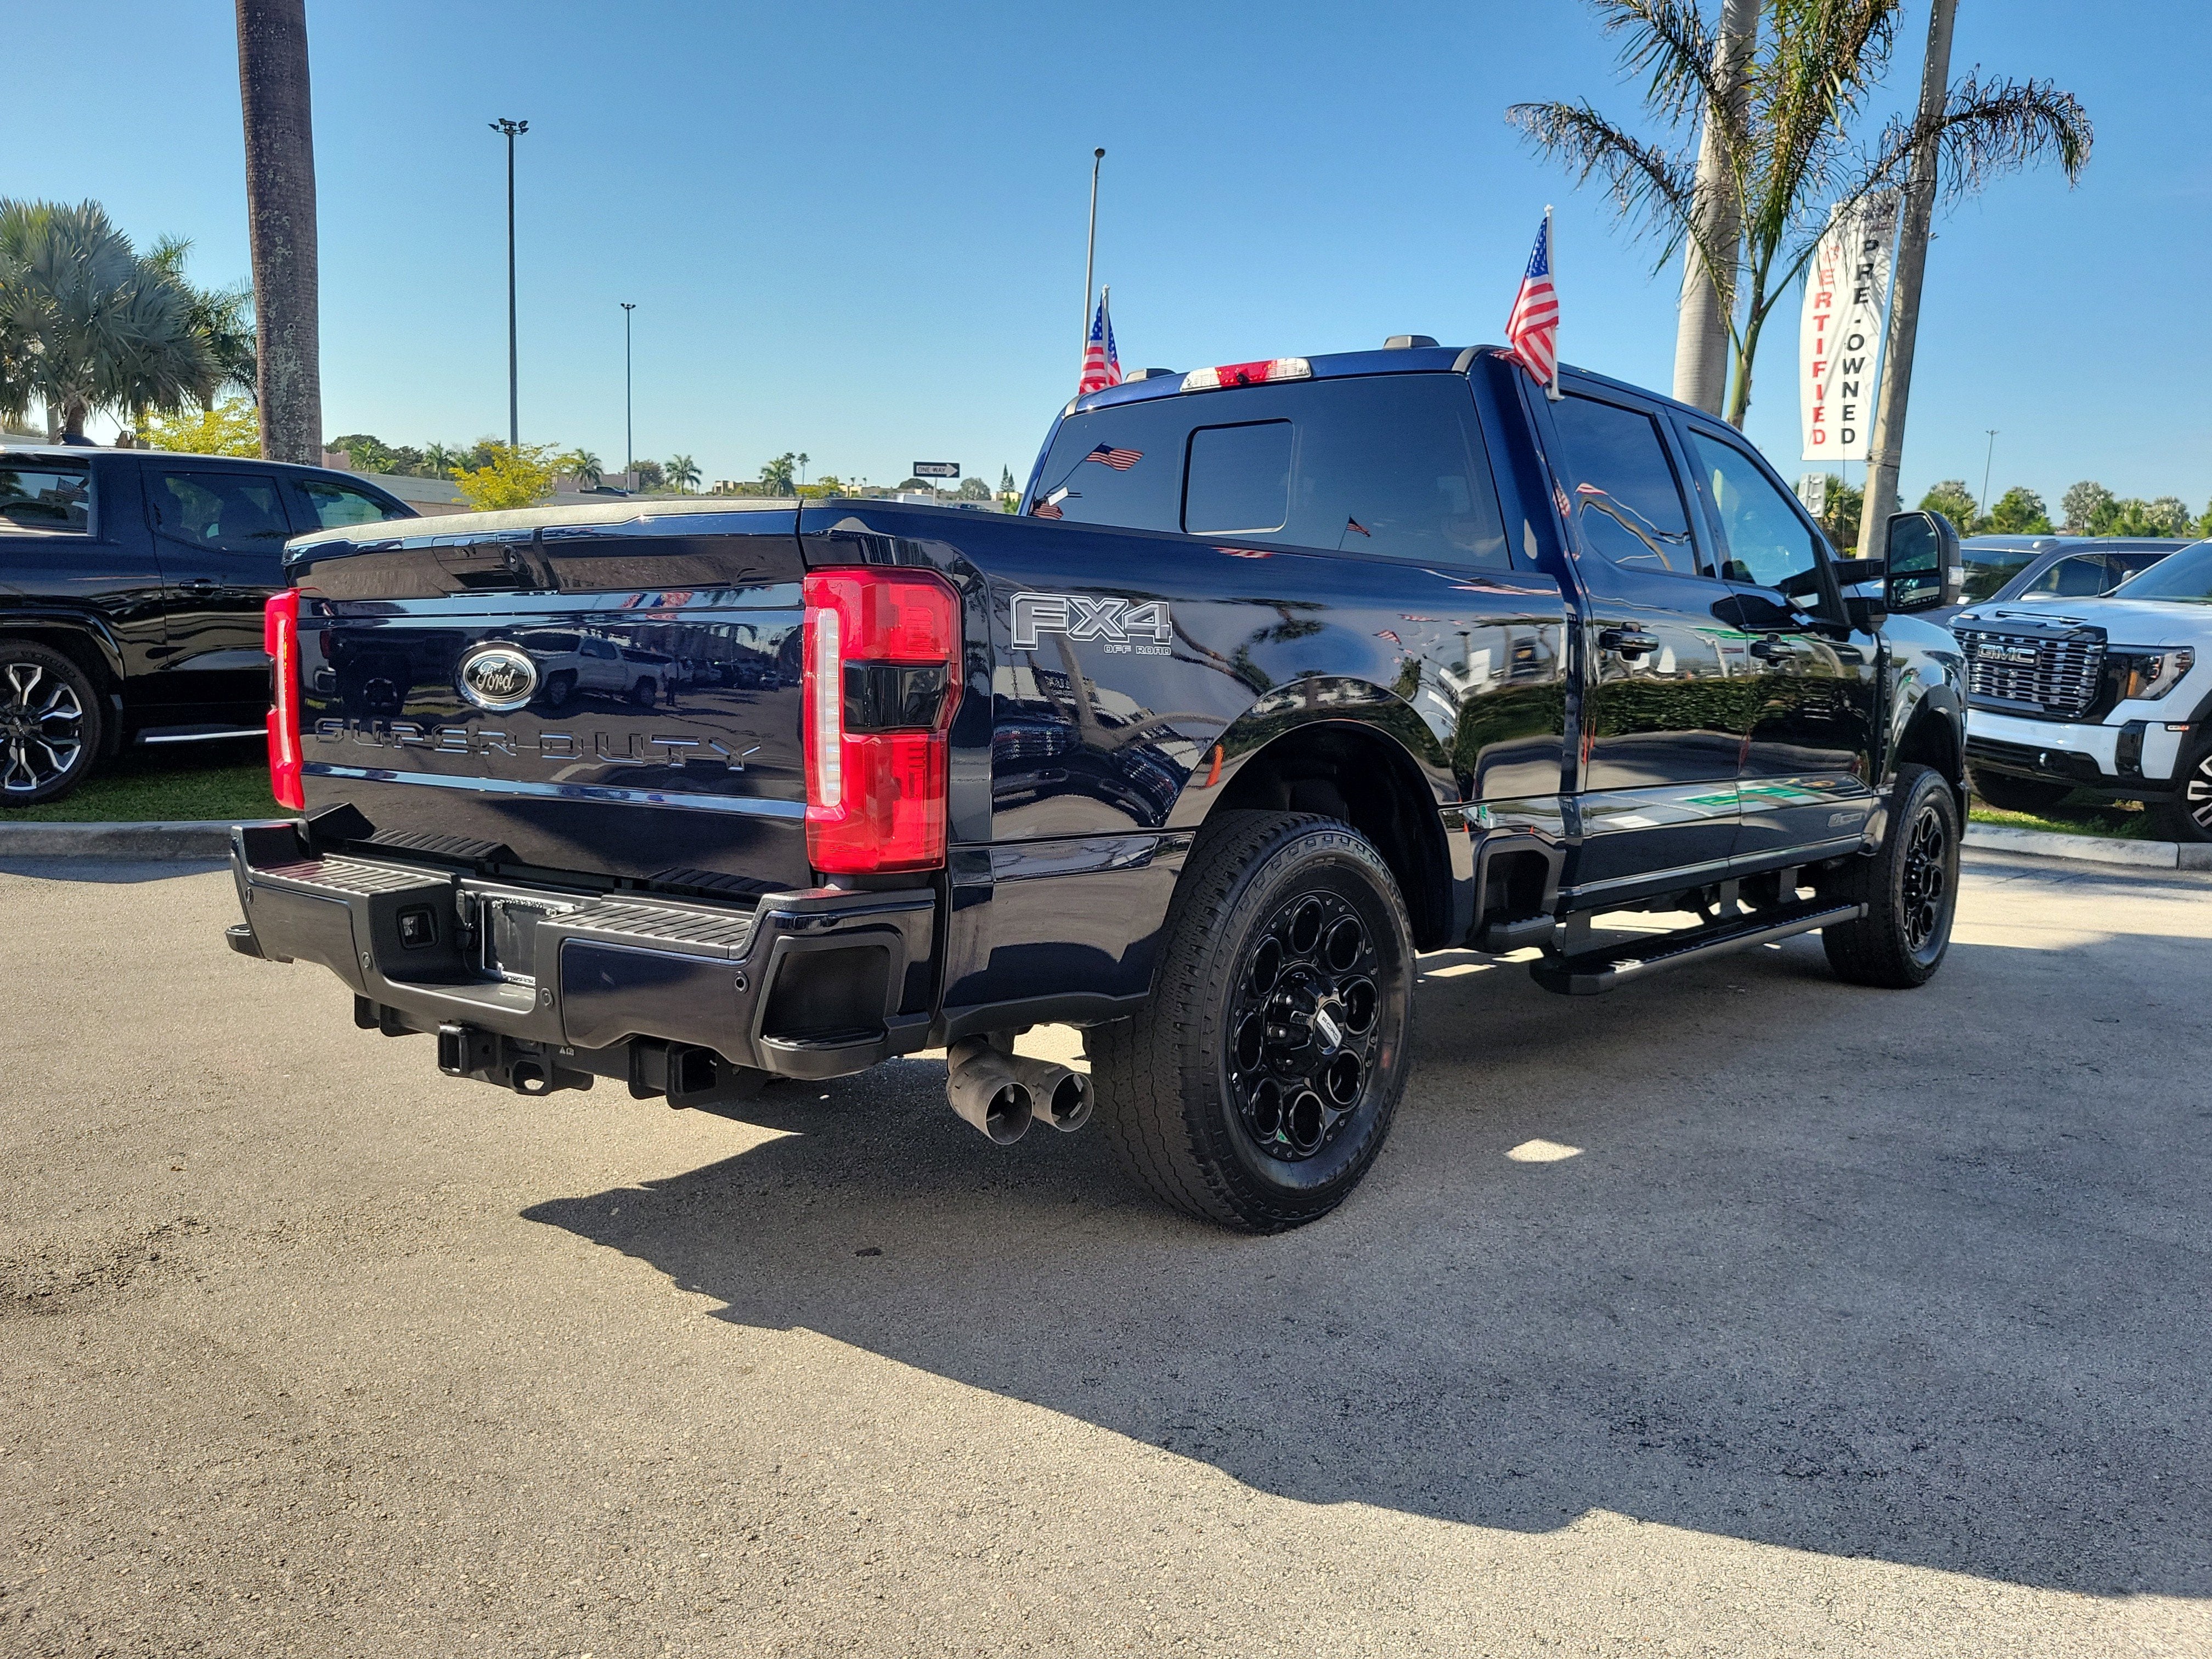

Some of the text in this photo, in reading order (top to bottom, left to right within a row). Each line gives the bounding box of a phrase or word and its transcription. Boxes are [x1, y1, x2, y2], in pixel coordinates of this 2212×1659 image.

[1010, 591, 1173, 650] FX4
[1103, 644, 1172, 656] OFF ROAD
[1978, 644, 2036, 663] GMC
[476, 661, 515, 691] Ford
[315, 718, 761, 772] SUPER DUTY
[1322, 1016, 1339, 1041] FORD
